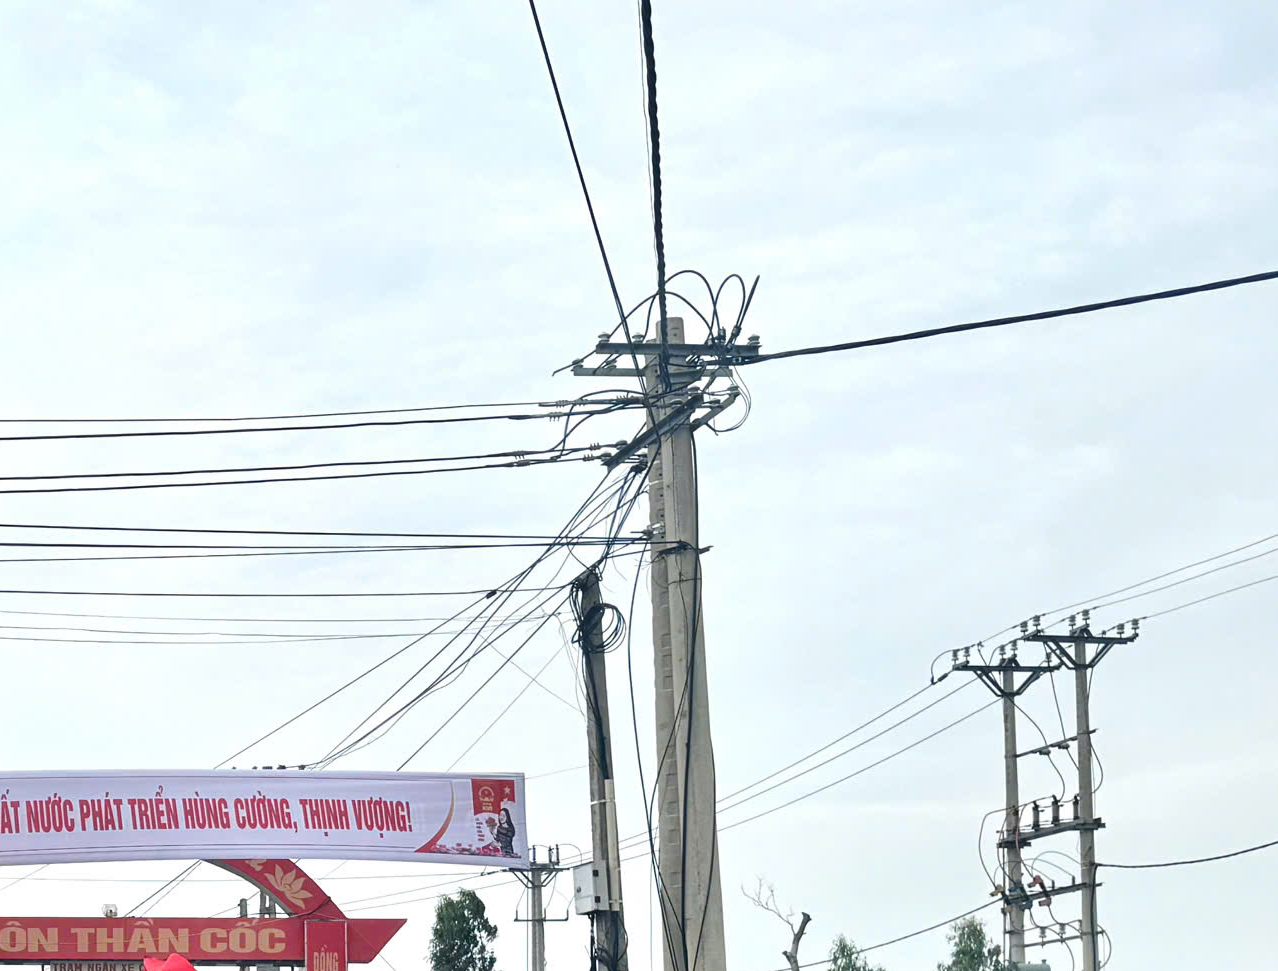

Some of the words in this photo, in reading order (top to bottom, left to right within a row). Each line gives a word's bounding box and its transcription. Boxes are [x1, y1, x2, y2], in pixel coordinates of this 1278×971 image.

[27, 796, 74, 832] NƯỚC
[80, 792, 123, 830] PHÁT
[129, 785, 180, 829] TRIỂN
[183, 792, 231, 829] HÙNG
[234, 790, 298, 833] CƯỜNG,
[300, 799, 350, 836] THỊNH
[353, 797, 412, 837] VƯỢNG!
[72, 918, 189, 953] THẦN
[199, 917, 286, 953] CỐC
